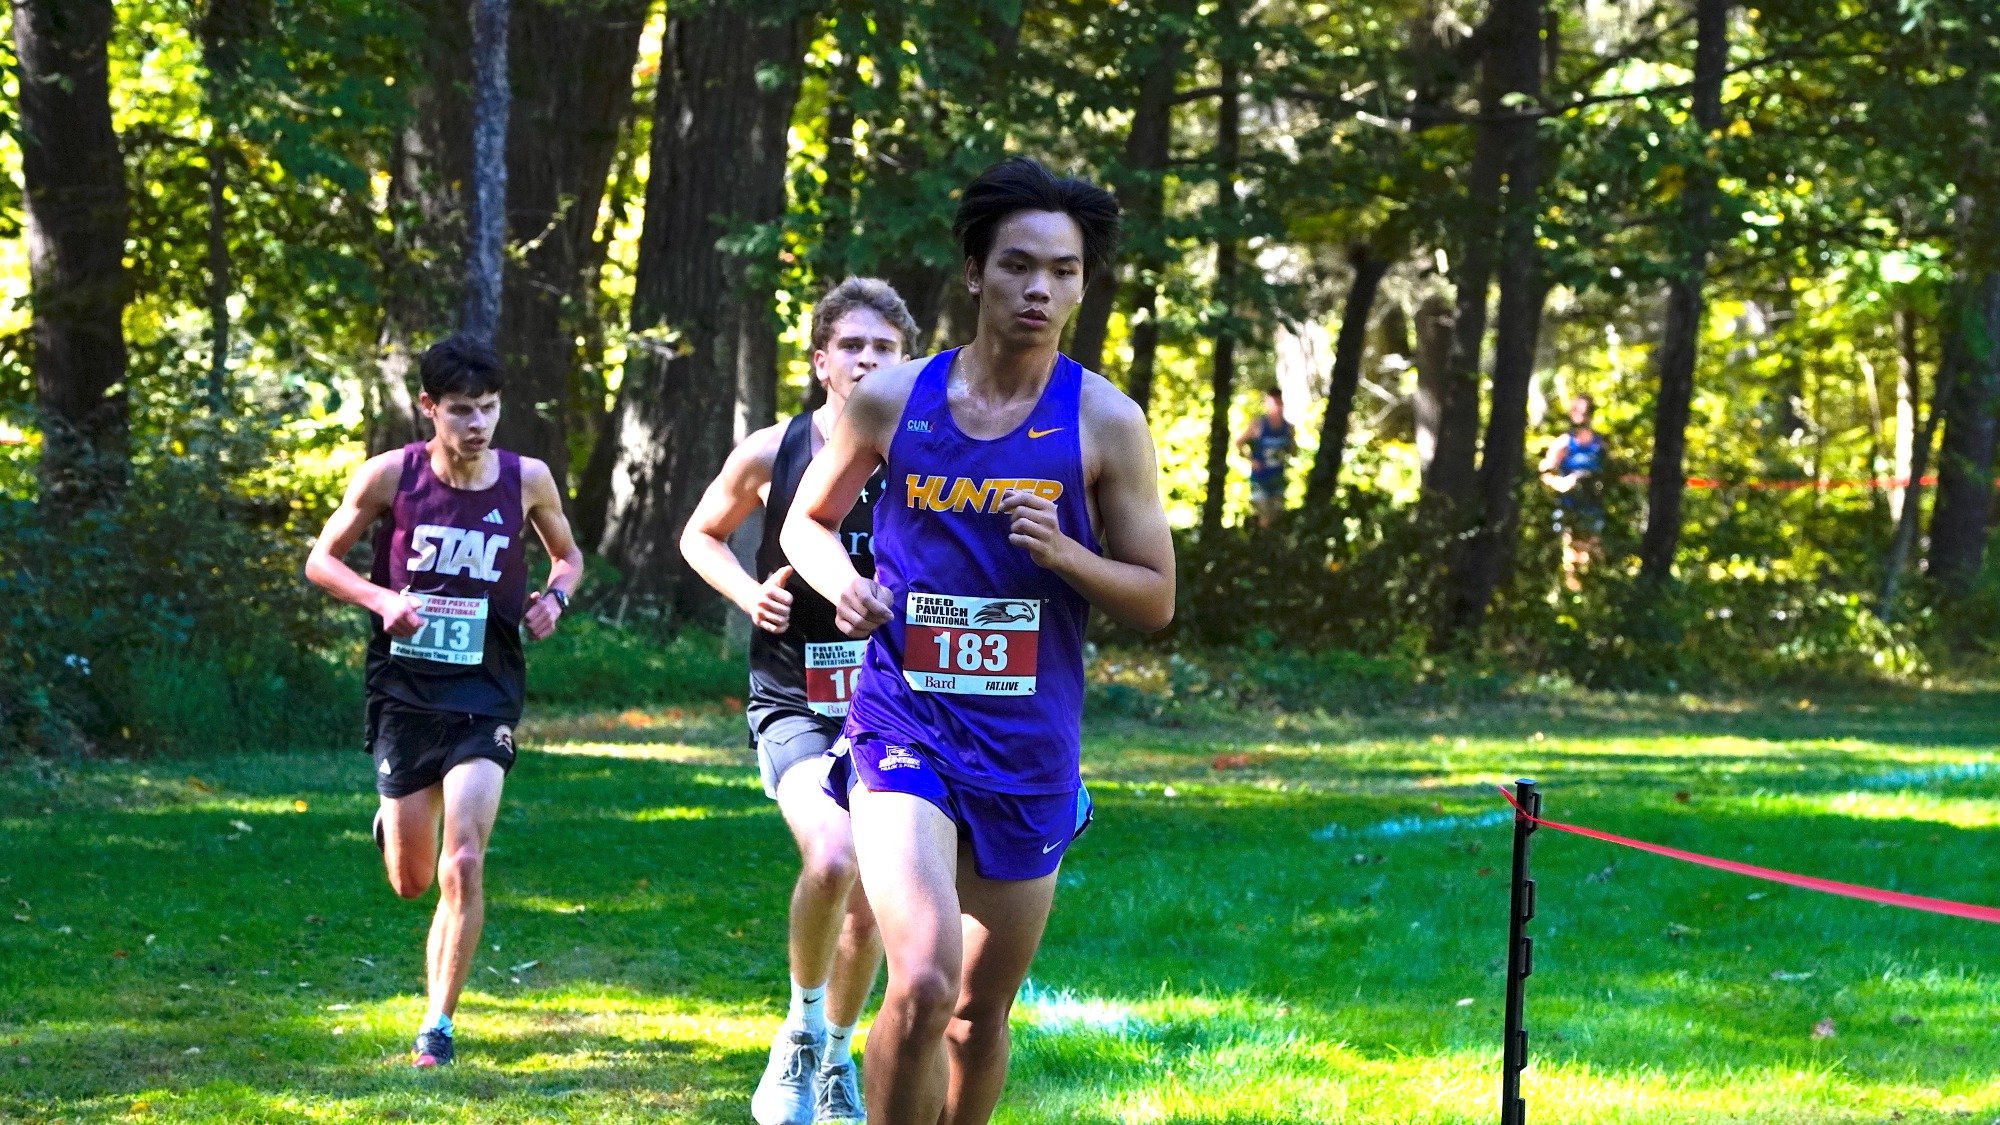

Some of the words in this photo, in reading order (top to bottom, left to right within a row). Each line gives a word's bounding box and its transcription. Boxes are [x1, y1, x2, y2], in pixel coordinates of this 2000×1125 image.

[407, 524, 510, 582] STAC
[917, 596, 954, 607] FRED
[425, 606, 477, 616] INVITATIONAL
[915, 605, 968, 617] PAVLICH
[915, 614, 969, 627] INVITATIONAL
[411, 618, 470, 651] 713
[812, 650, 855, 660] PAVLICH
[933, 631, 1008, 672] 183
[813, 658, 857, 666] INVITATIONAL
[925, 676, 956, 690] Bard
[985, 681, 1020, 691] FAT.LIVE
